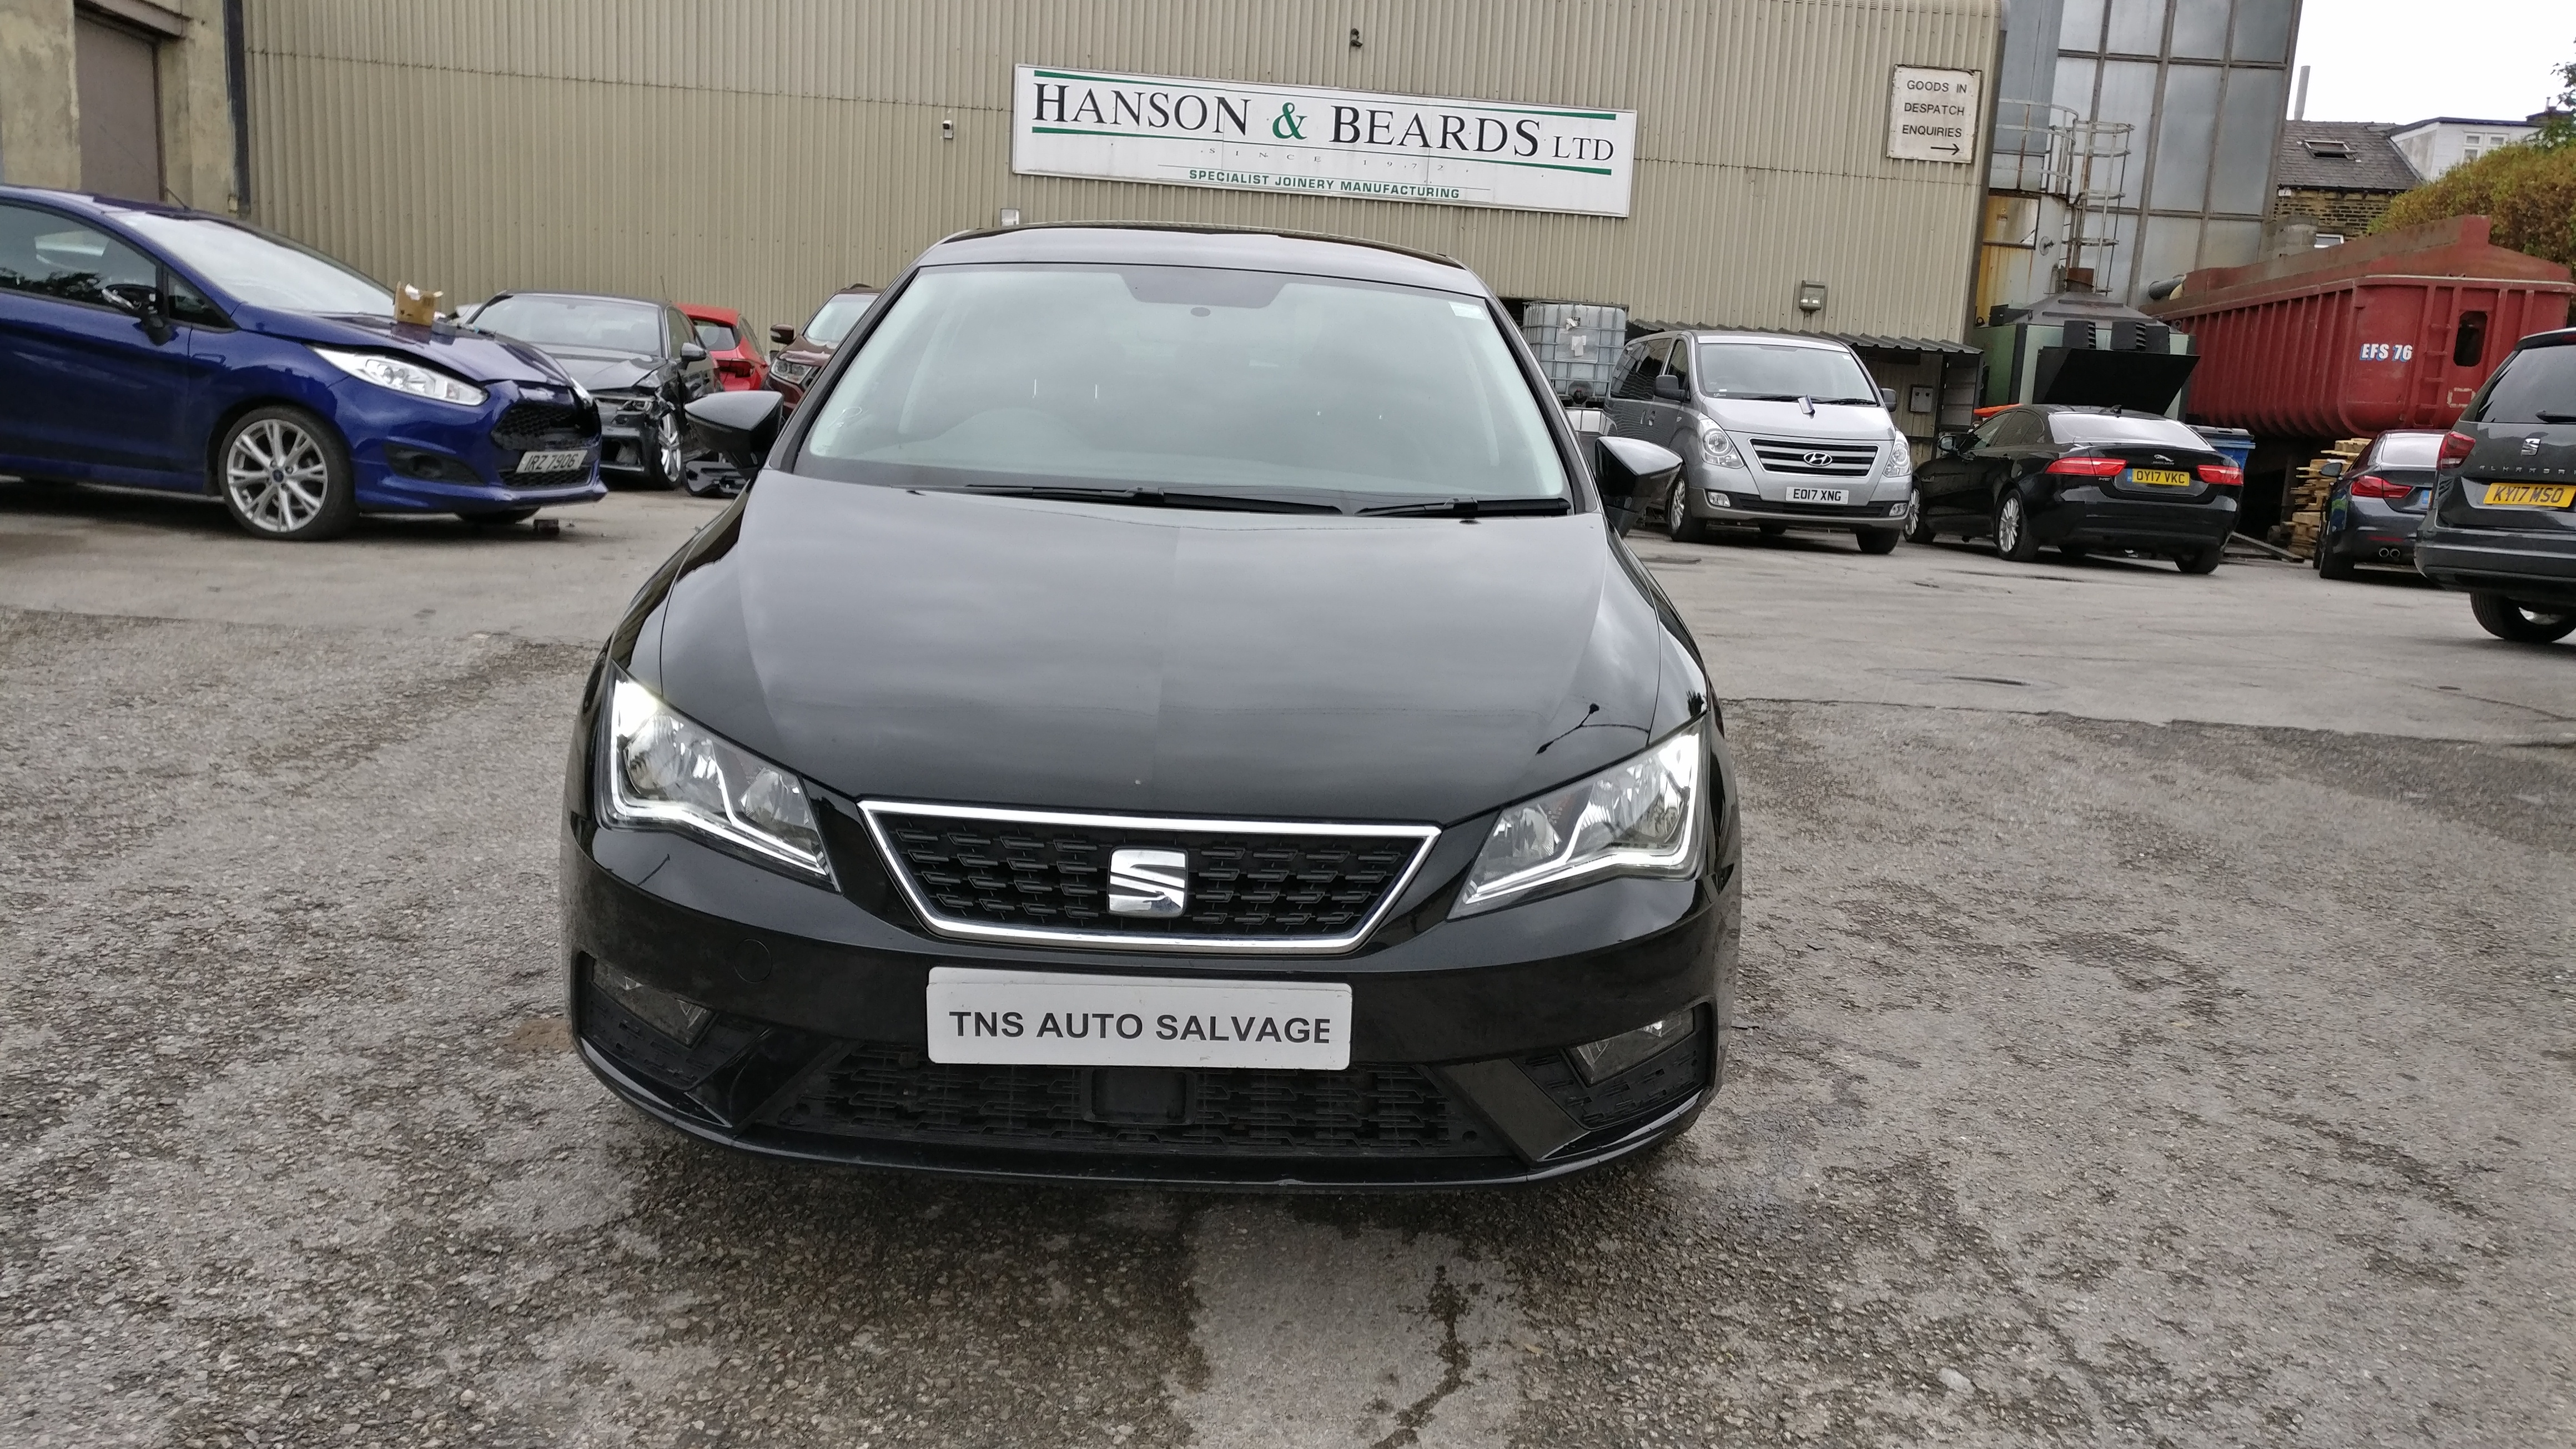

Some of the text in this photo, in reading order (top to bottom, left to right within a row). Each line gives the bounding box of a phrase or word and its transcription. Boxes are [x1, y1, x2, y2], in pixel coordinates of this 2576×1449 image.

[1906, 80, 1968, 93] GOODS IN
[1904, 103, 1965, 116] DESPATCH
[1032, 83, 1614, 161] HANSON & BEARDS LTD
[1902, 124, 1962, 138] ENQUIRIES
[1209, 147, 1321, 162] SINCE
[1189, 169, 1460, 199] SPECIALIST JOINERY MANUFACTURING
[2359, 343, 2413, 362] EFS 76
[524, 453, 578, 471] IRZ 7906
[2136, 470, 2185, 484] OY17 VKC
[1793, 489, 1842, 502] EO17 XNG
[2493, 486, 2565, 504] KY17 MSO
[949, 1011, 1331, 1044] TNS AUTO SALVAGE
